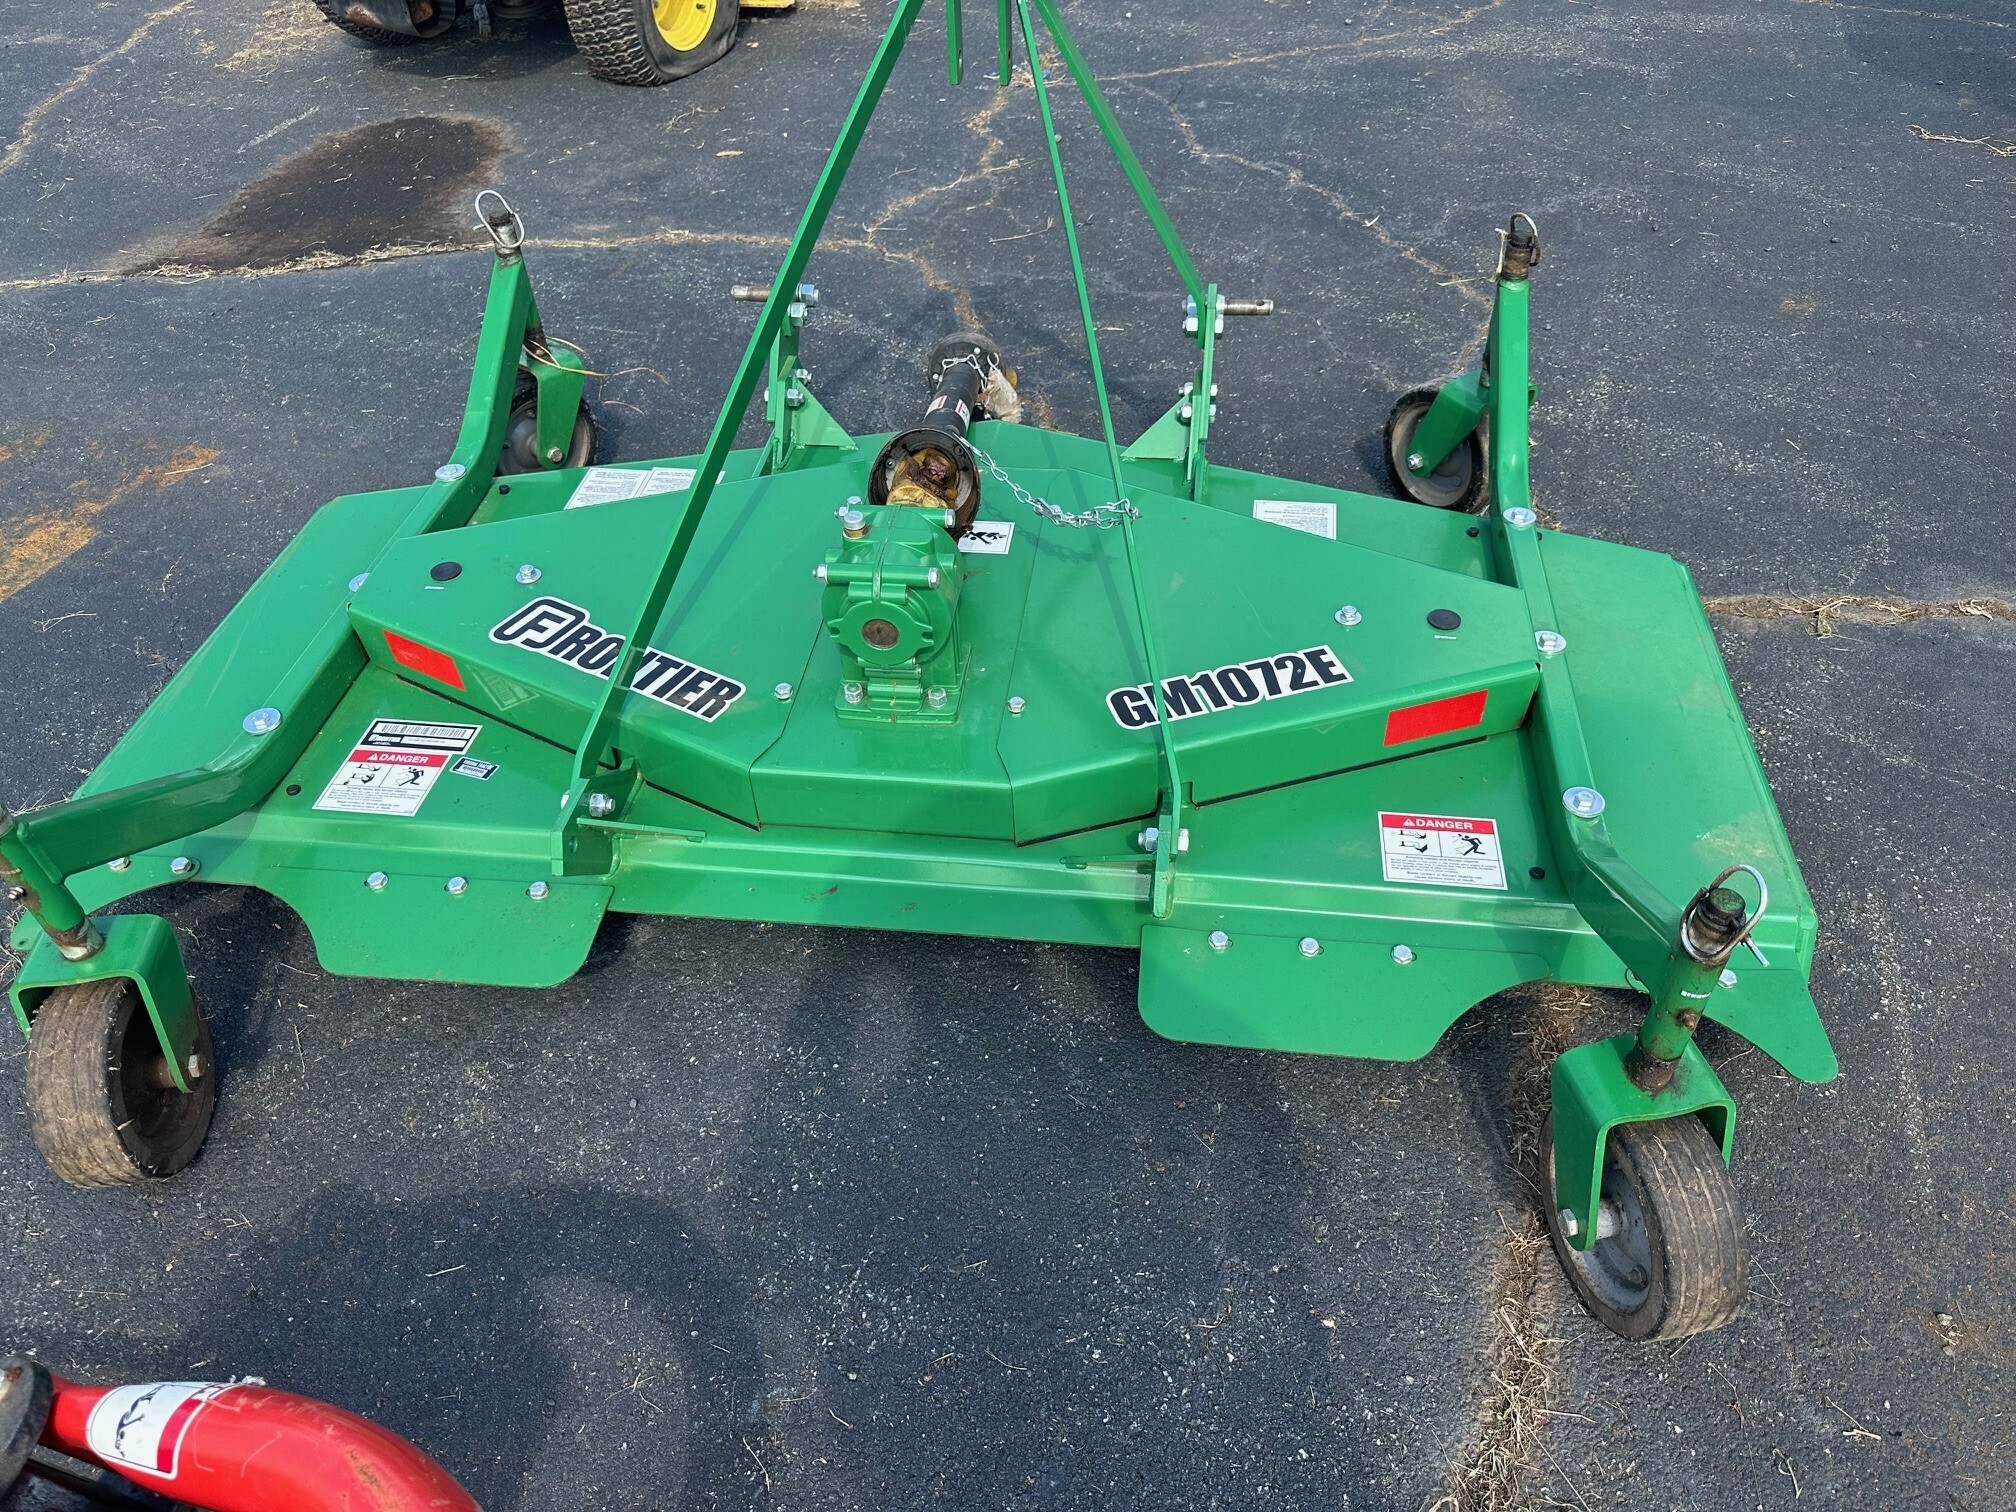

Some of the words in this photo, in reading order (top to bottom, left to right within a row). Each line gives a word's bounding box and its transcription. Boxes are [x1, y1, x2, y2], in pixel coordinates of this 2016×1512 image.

[1108, 646, 1350, 729] GM1072E
[379, 753, 430, 765] DANGER
[1415, 818, 1474, 831] DANGER
